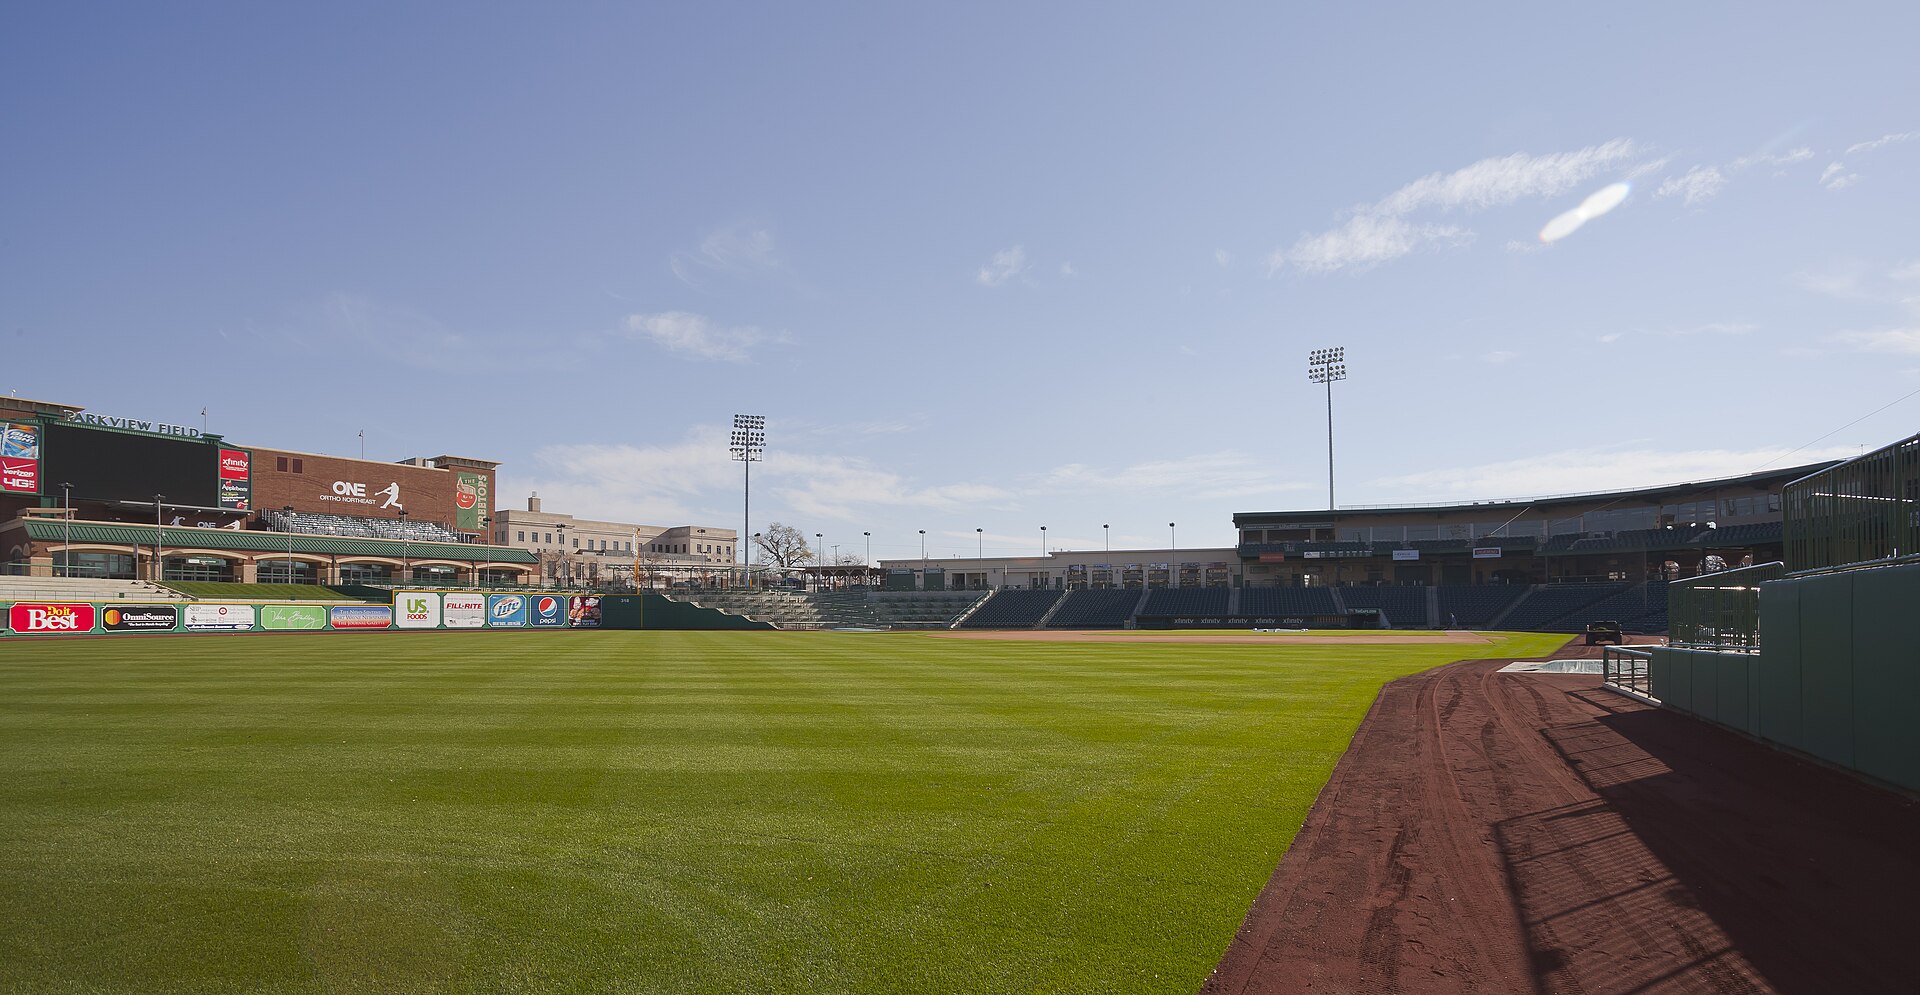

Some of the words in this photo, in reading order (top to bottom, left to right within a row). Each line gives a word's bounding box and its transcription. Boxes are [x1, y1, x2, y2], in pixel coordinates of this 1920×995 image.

[64, 410, 151, 431] PARKVIEW
[158, 423, 200, 438] FIELD
[222, 458, 248, 468] xfinity
[3, 469, 34, 477] verizon
[332, 481, 366, 497] ONE
[319, 494, 341, 502] ORTHO
[342, 496, 377, 505] NORTHEAST
[46, 606, 63, 616] Do
[63, 606, 71, 616] it
[26, 609, 79, 630] Best
[122, 612, 175, 621] OmniSource
